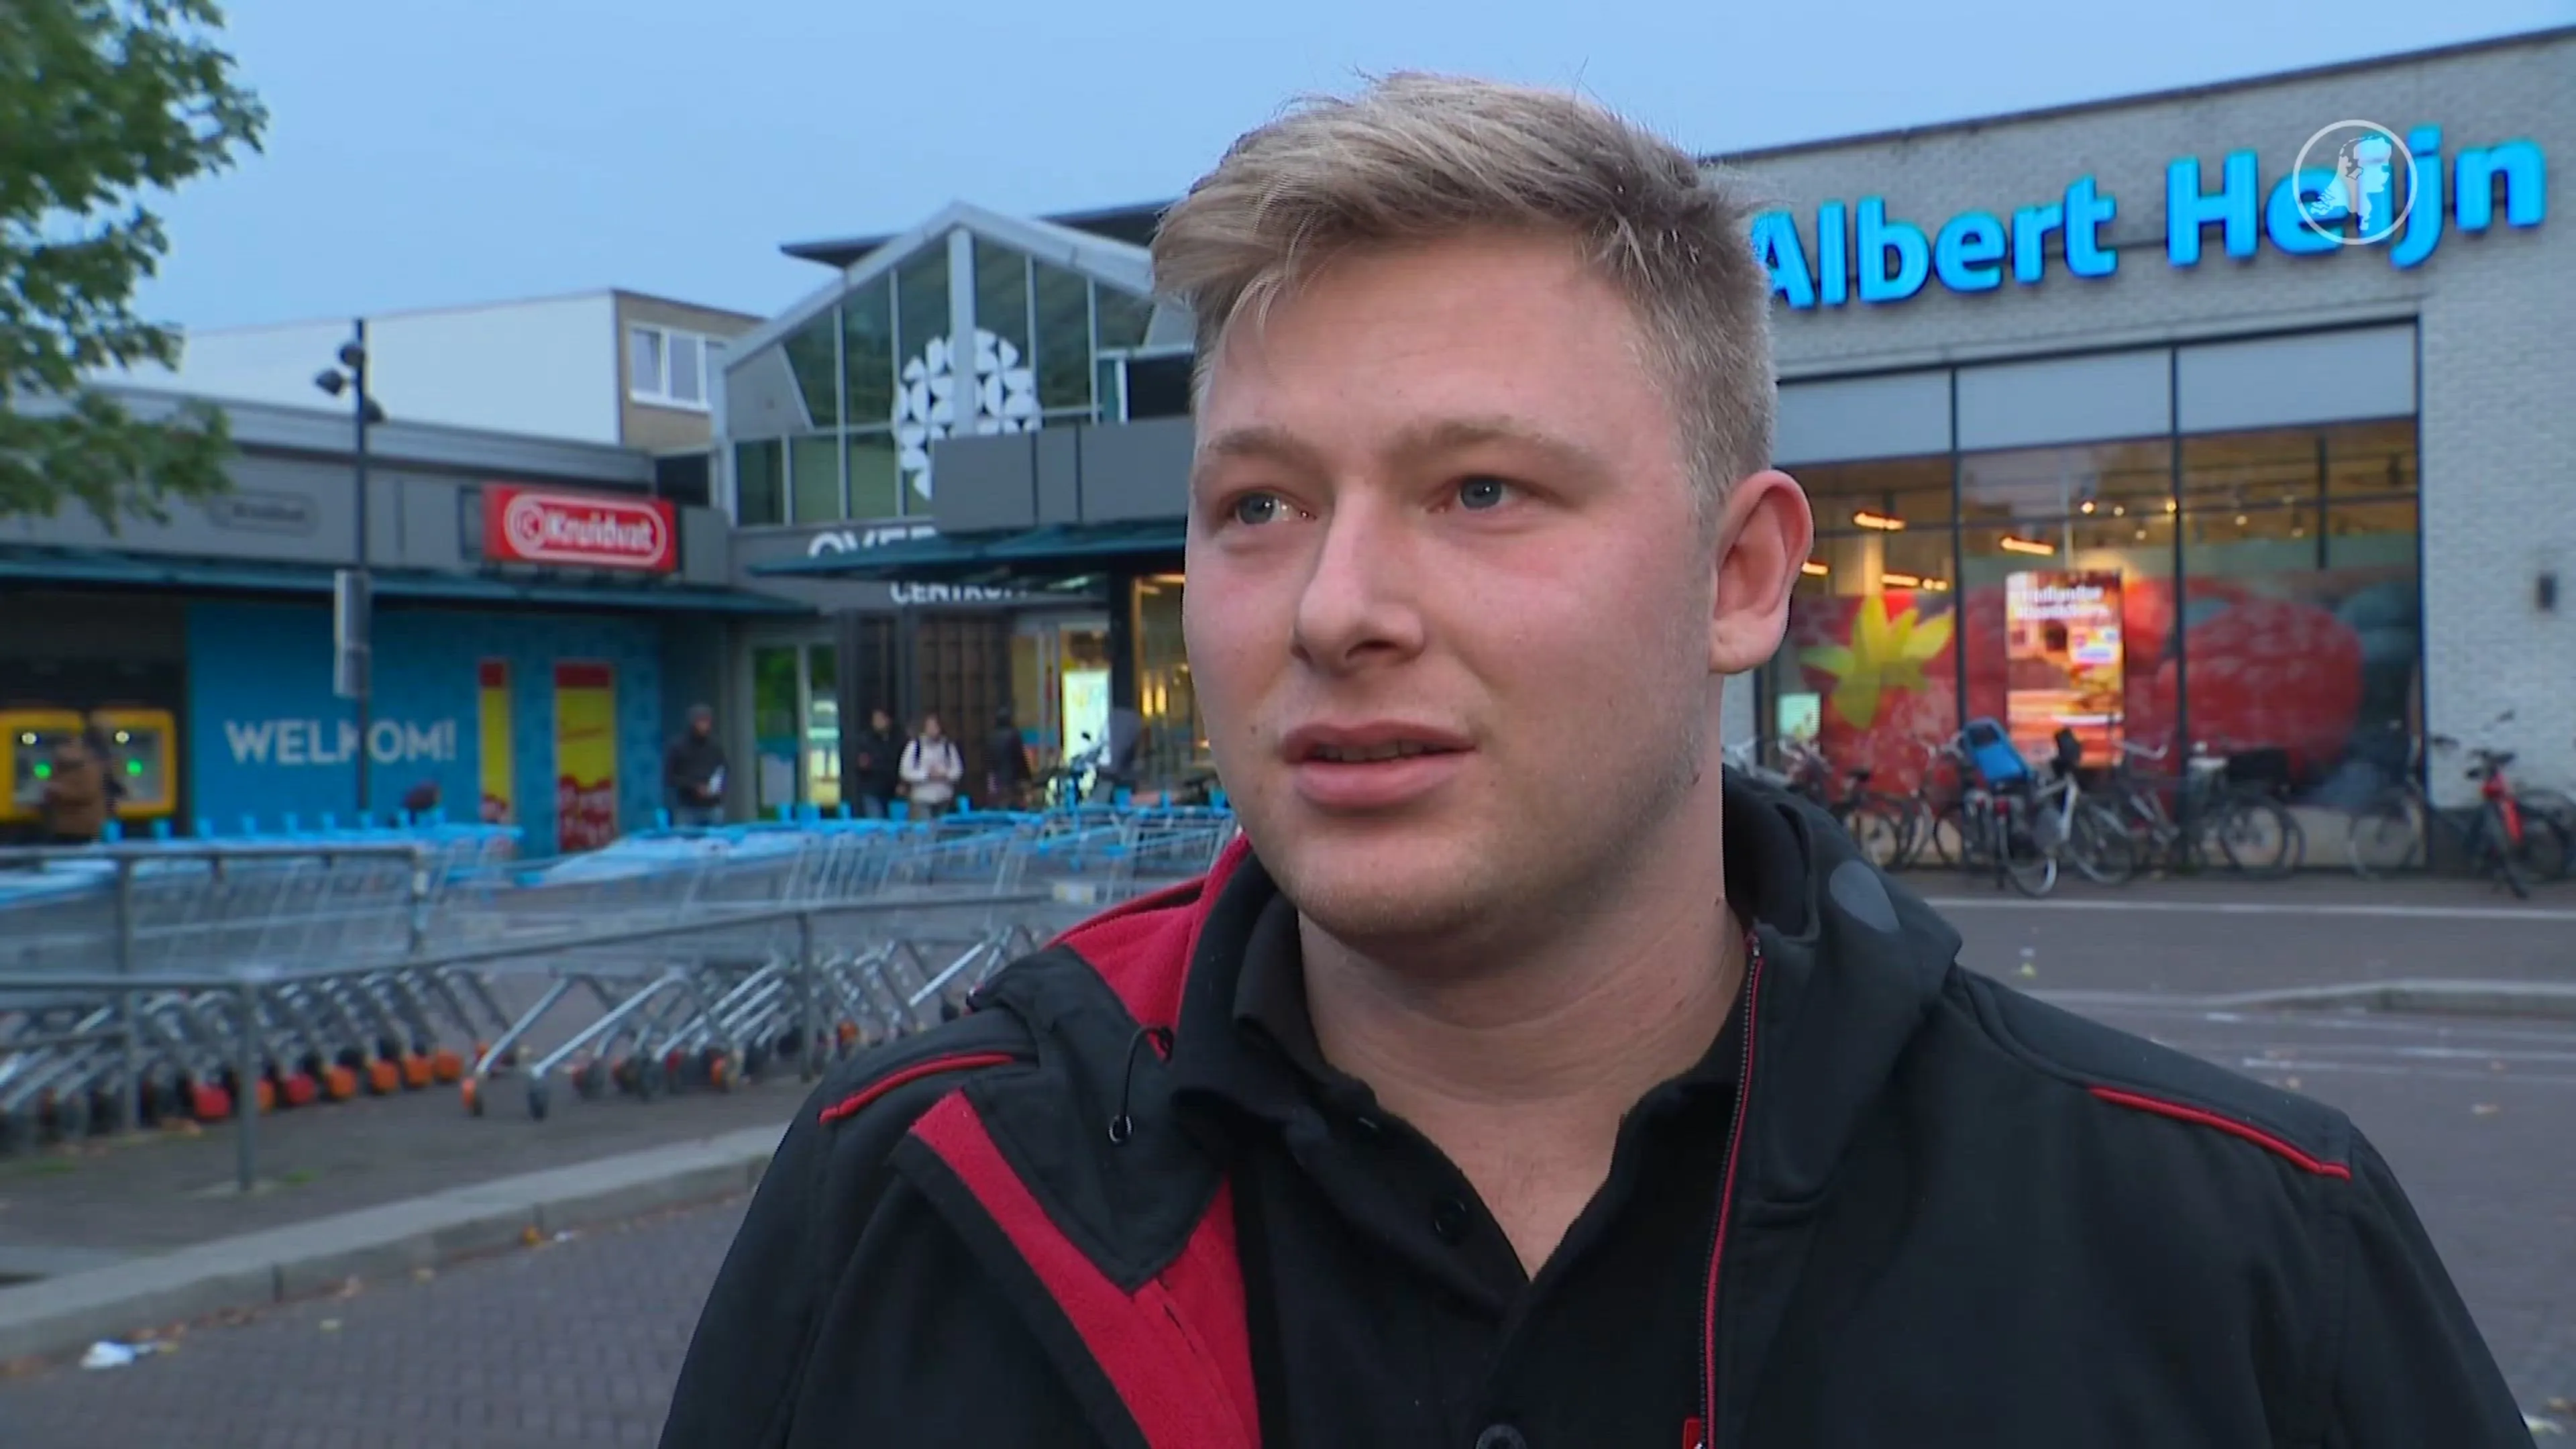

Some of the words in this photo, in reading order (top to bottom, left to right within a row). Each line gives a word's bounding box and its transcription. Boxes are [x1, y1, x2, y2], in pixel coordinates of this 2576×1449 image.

[1750, 174, 2118, 309] Albert
[2166, 123, 2544, 268] Heijn
[545, 511, 655, 550] Kruidvat
[890, 580, 1030, 605] CENTR
[223, 719, 458, 766] WELKOM!
